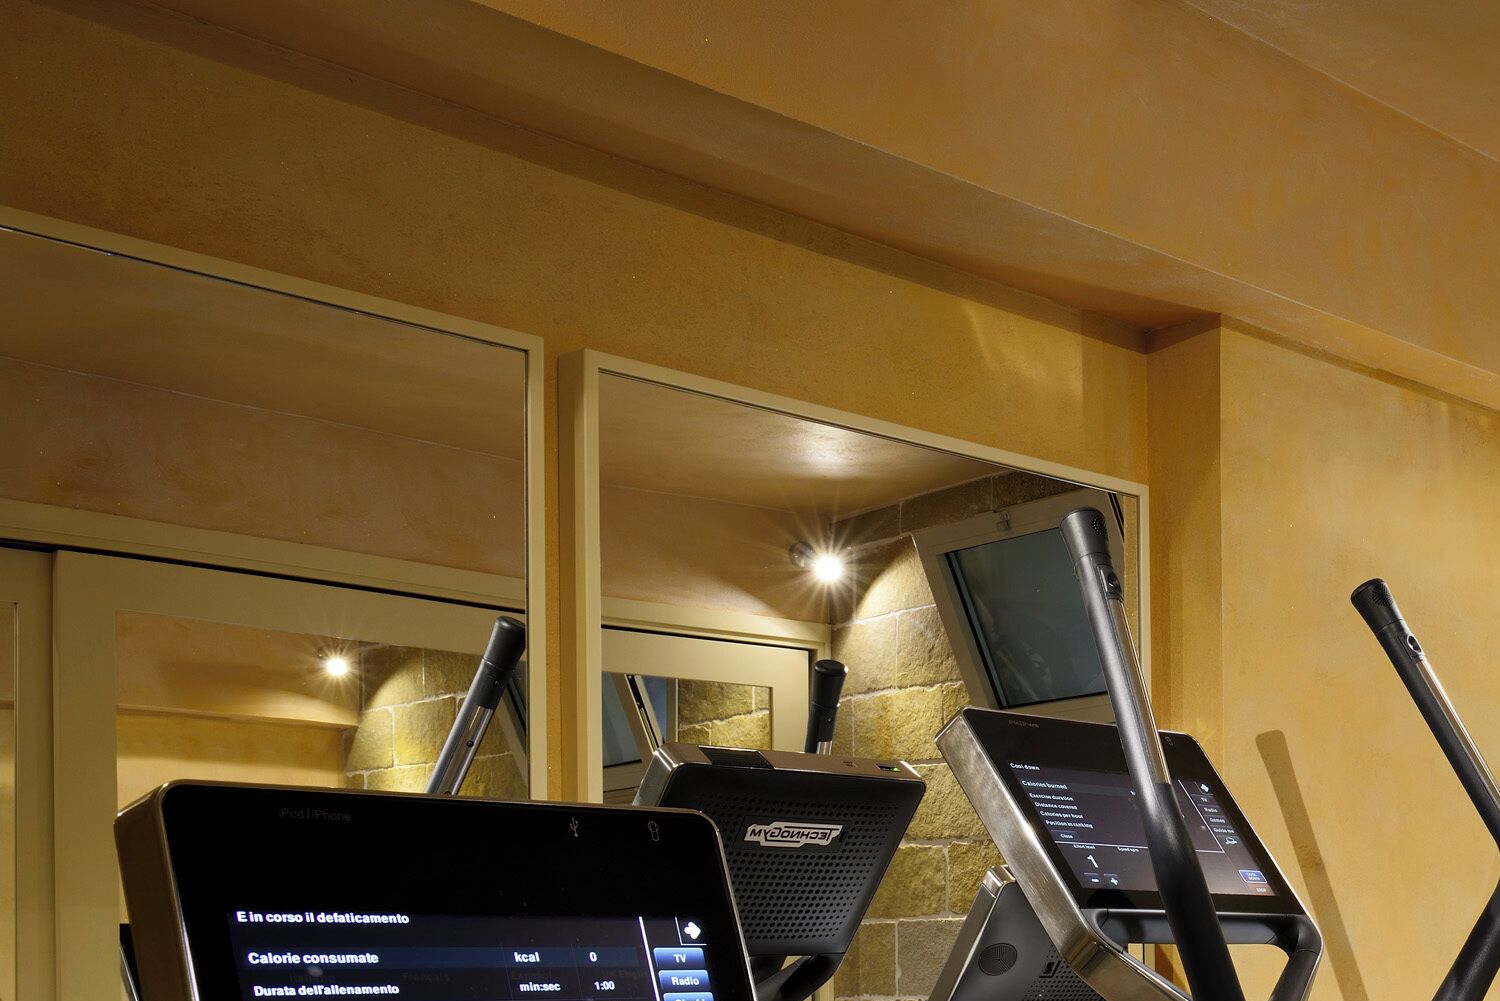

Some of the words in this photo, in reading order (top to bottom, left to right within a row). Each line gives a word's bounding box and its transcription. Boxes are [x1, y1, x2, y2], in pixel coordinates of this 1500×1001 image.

[1087, 854, 1099, 868] 1
[250, 911, 263, 922] in
[265, 912, 303, 923] corso
[305, 912, 315, 923] il
[316, 912, 410, 924] defaticamento
[247, 952, 301, 964] Calorie
[302, 952, 380, 964] consumate
[513, 951, 540, 963] kcal
[588, 951, 598, 962] 0
[672, 953, 687, 964] TV
[519, 982, 561, 992] min:sec
[593, 980, 616, 991] 1:00
[671, 976, 700, 987] Radio
[253, 985, 297, 997] Durata
[298, 984, 400, 996] dell'allenamento
